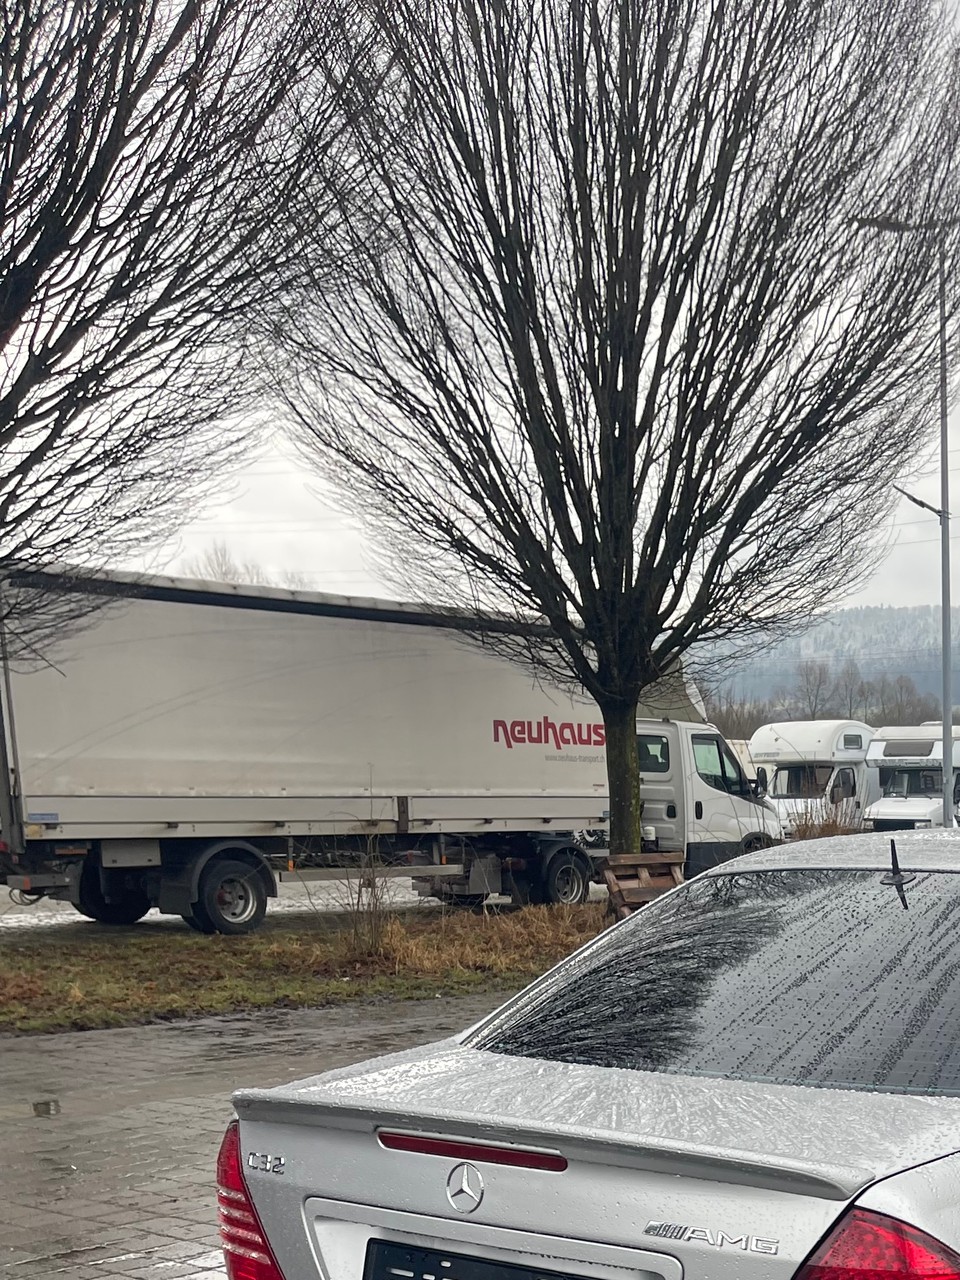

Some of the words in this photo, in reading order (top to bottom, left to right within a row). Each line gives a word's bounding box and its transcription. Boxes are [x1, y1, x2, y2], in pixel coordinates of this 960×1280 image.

[493, 716, 606, 750] neuhaus
[247, 1151, 285, 1175] C32
[683, 1226, 779, 1255] AMG
